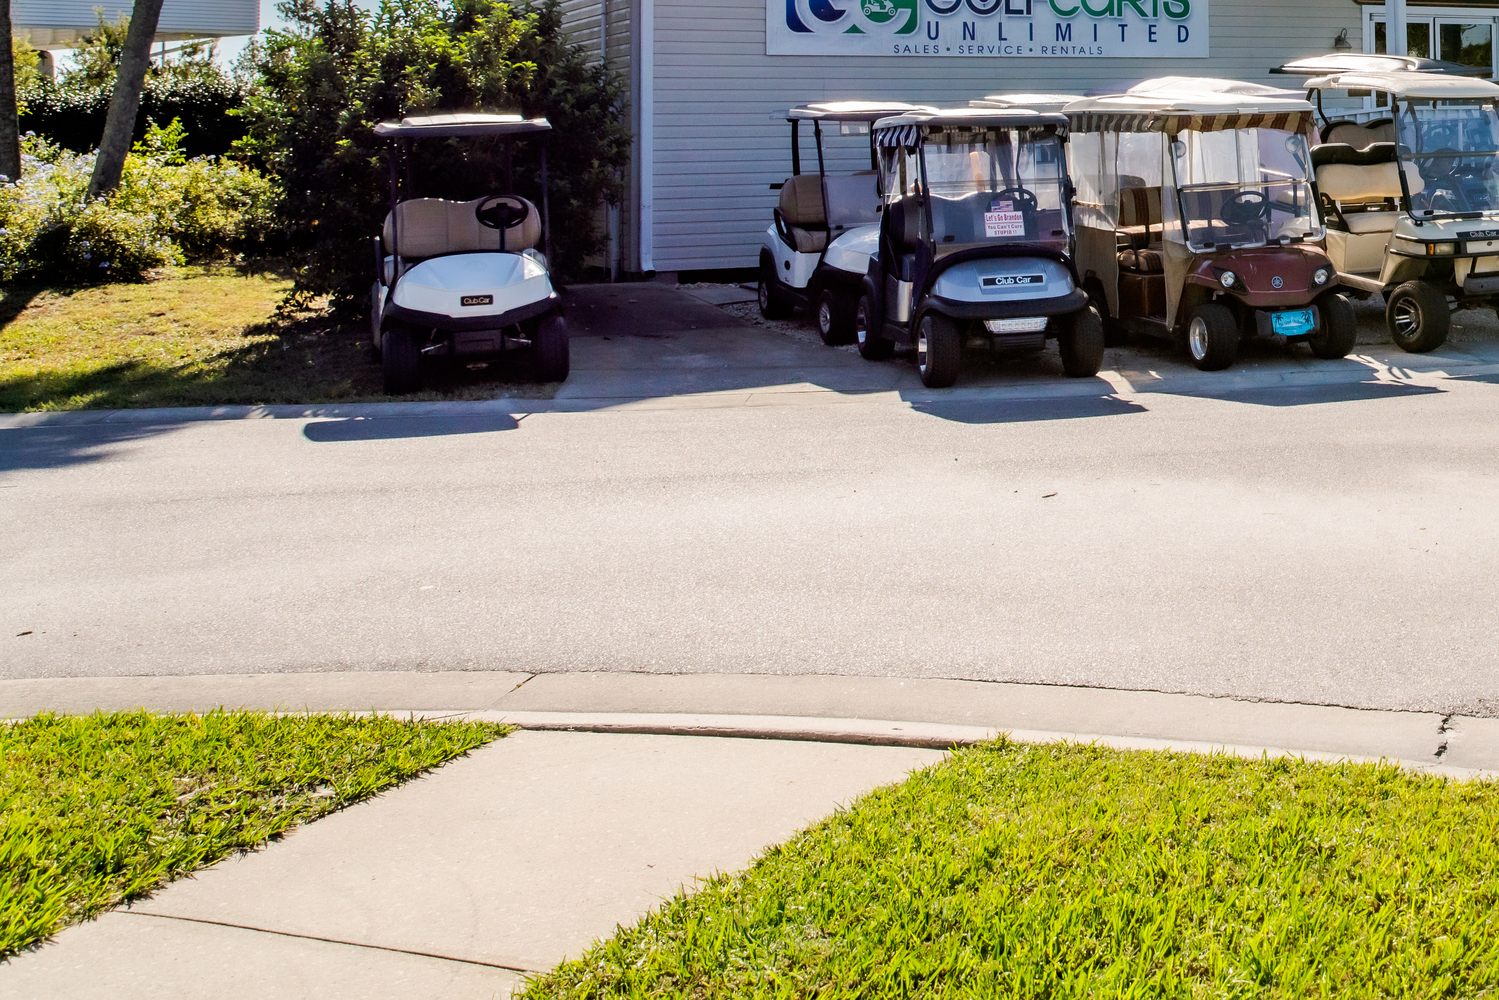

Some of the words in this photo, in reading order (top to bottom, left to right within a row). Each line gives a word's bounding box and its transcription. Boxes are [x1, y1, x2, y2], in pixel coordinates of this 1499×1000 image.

[927, 20, 1190, 43] UNLIMITED
[893, 44, 940, 54] SALES
[958, 44, 1023, 55] SERVICE
[1041, 45, 1103, 56] RENTALS
[997, 213, 1003, 221] Go
[1004, 213, 1022, 221] Brandon
[996, 277, 1015, 285] Club
[1016, 276, 1031, 284] Car
